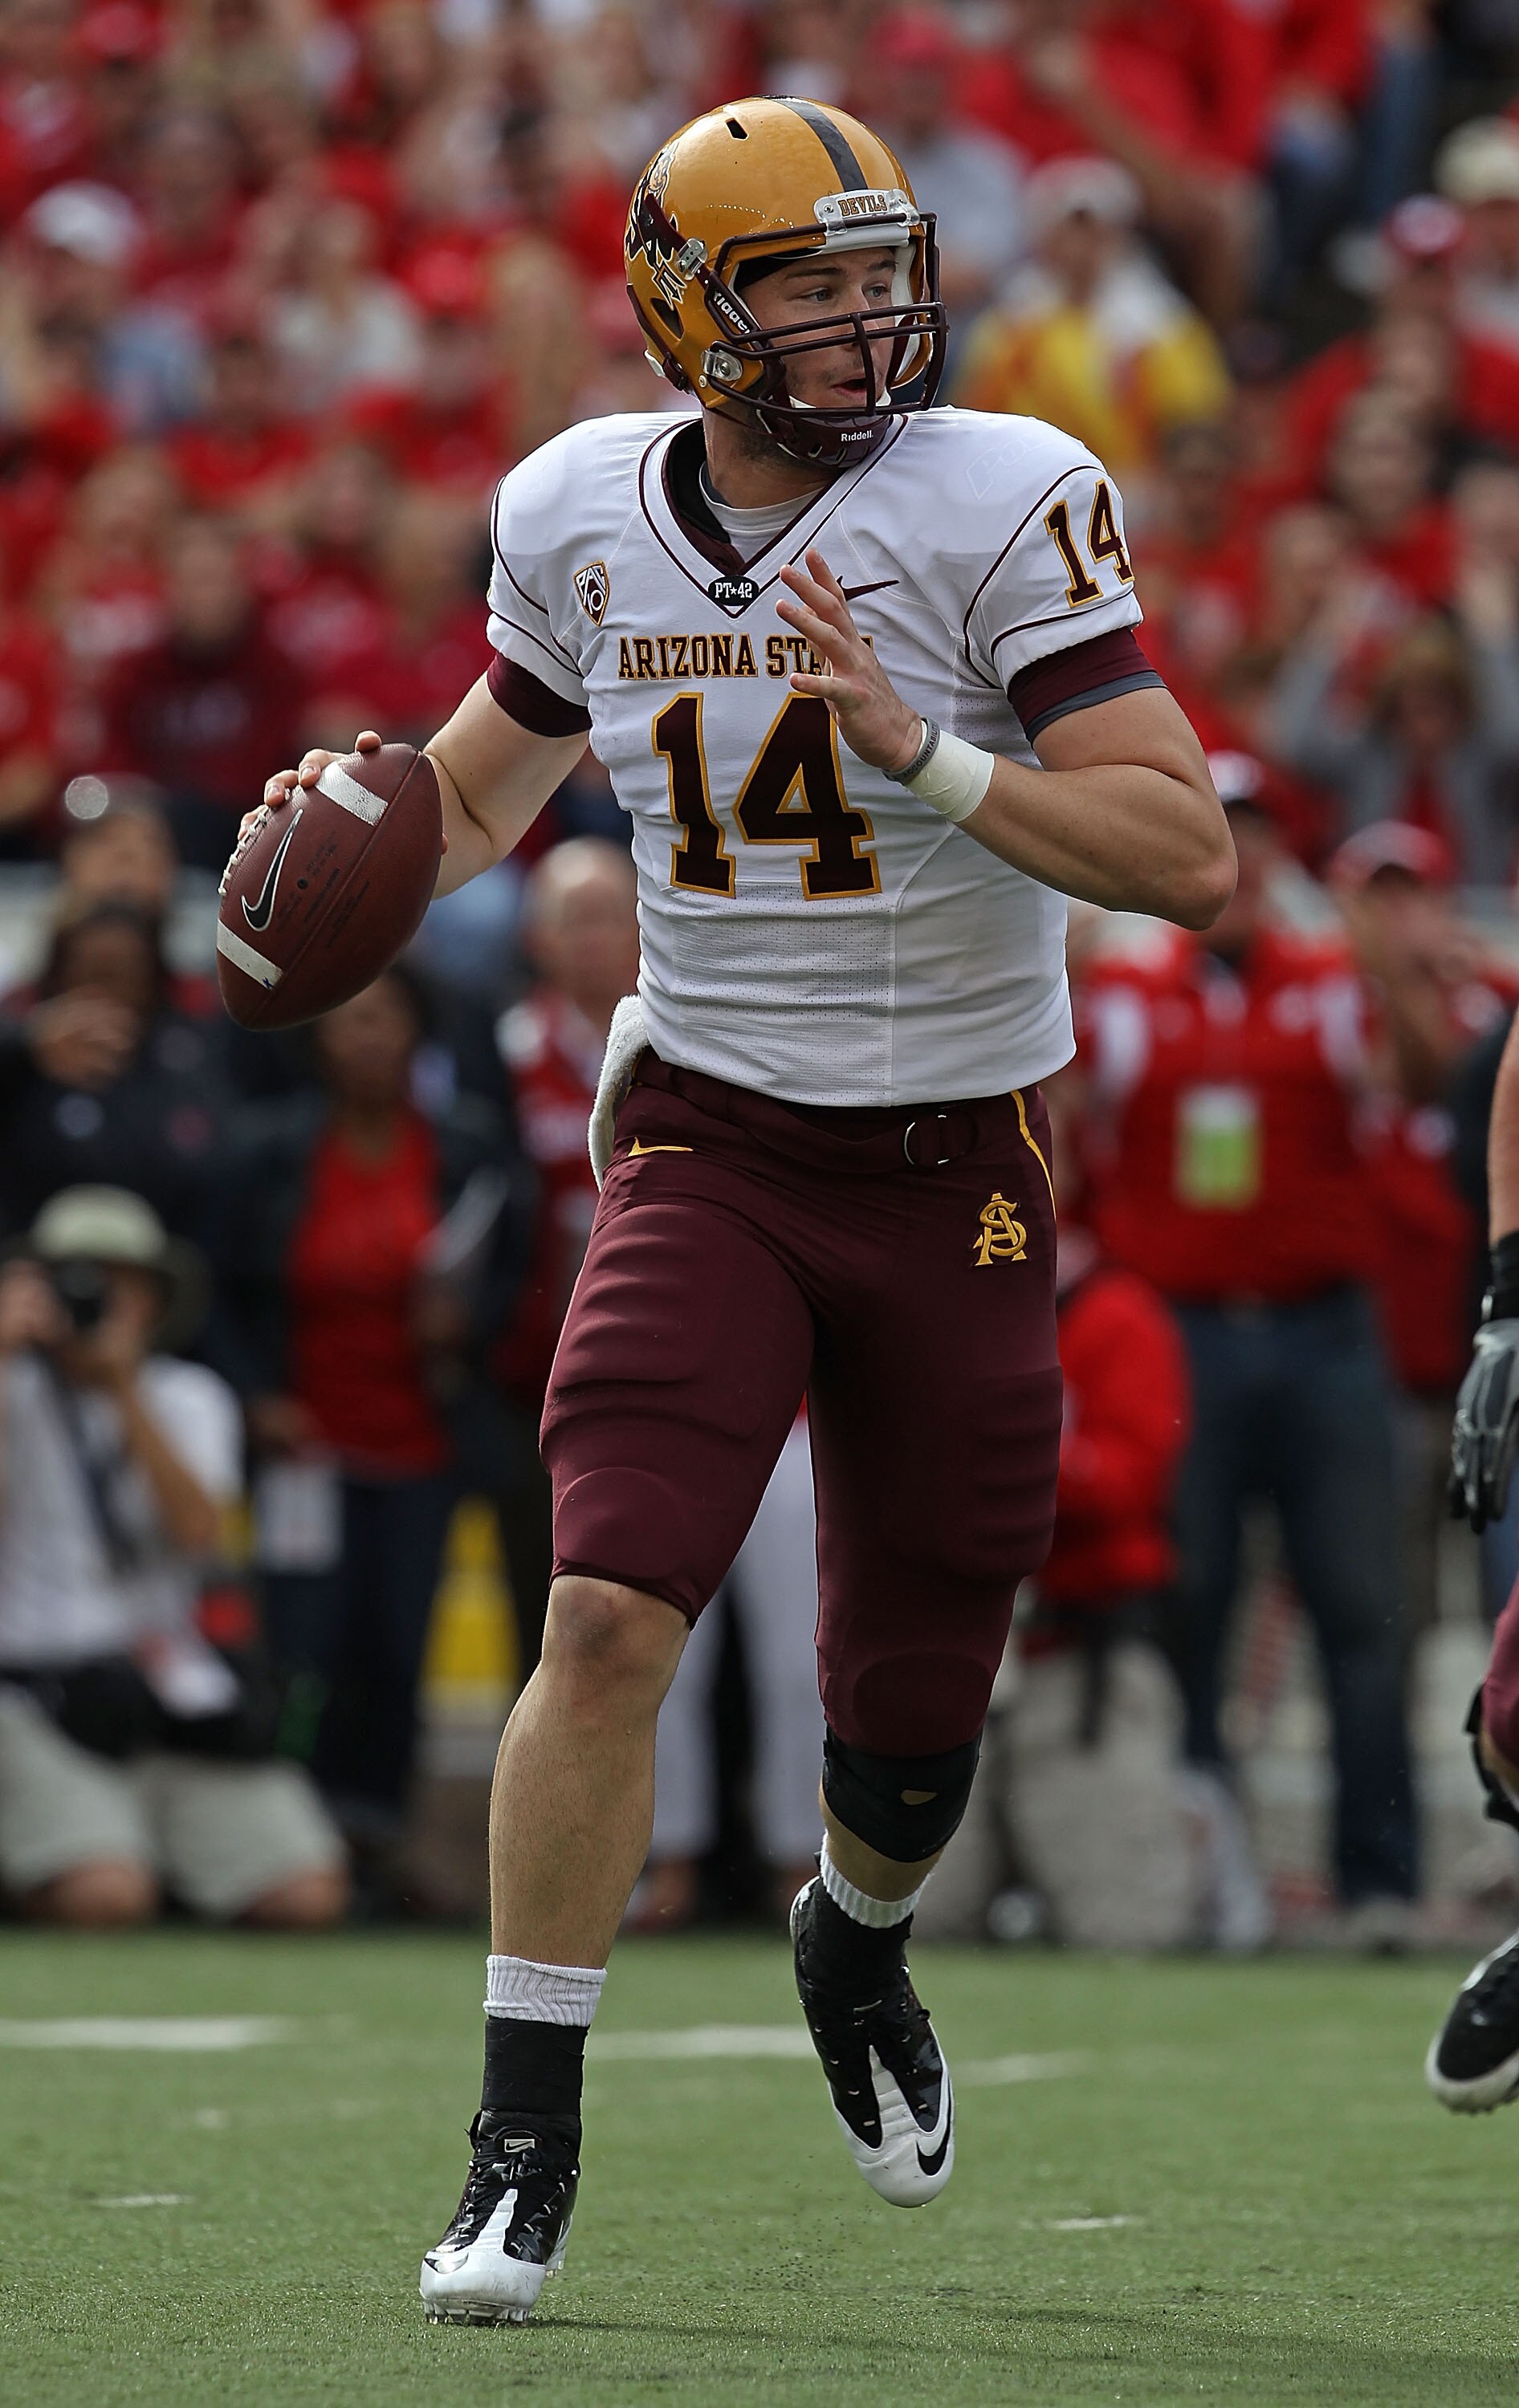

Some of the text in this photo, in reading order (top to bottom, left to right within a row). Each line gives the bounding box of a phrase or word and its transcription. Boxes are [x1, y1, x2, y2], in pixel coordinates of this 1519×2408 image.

[837, 194, 888, 218] DEVILS
[841, 429, 873, 441] Riddell
[1043, 478, 1135, 608] 14
[575, 564, 607, 606] PAC
[587, 589, 605, 615] 10
[617, 632, 874, 680] ARIZONA STA
[651, 690, 882, 901] 14
